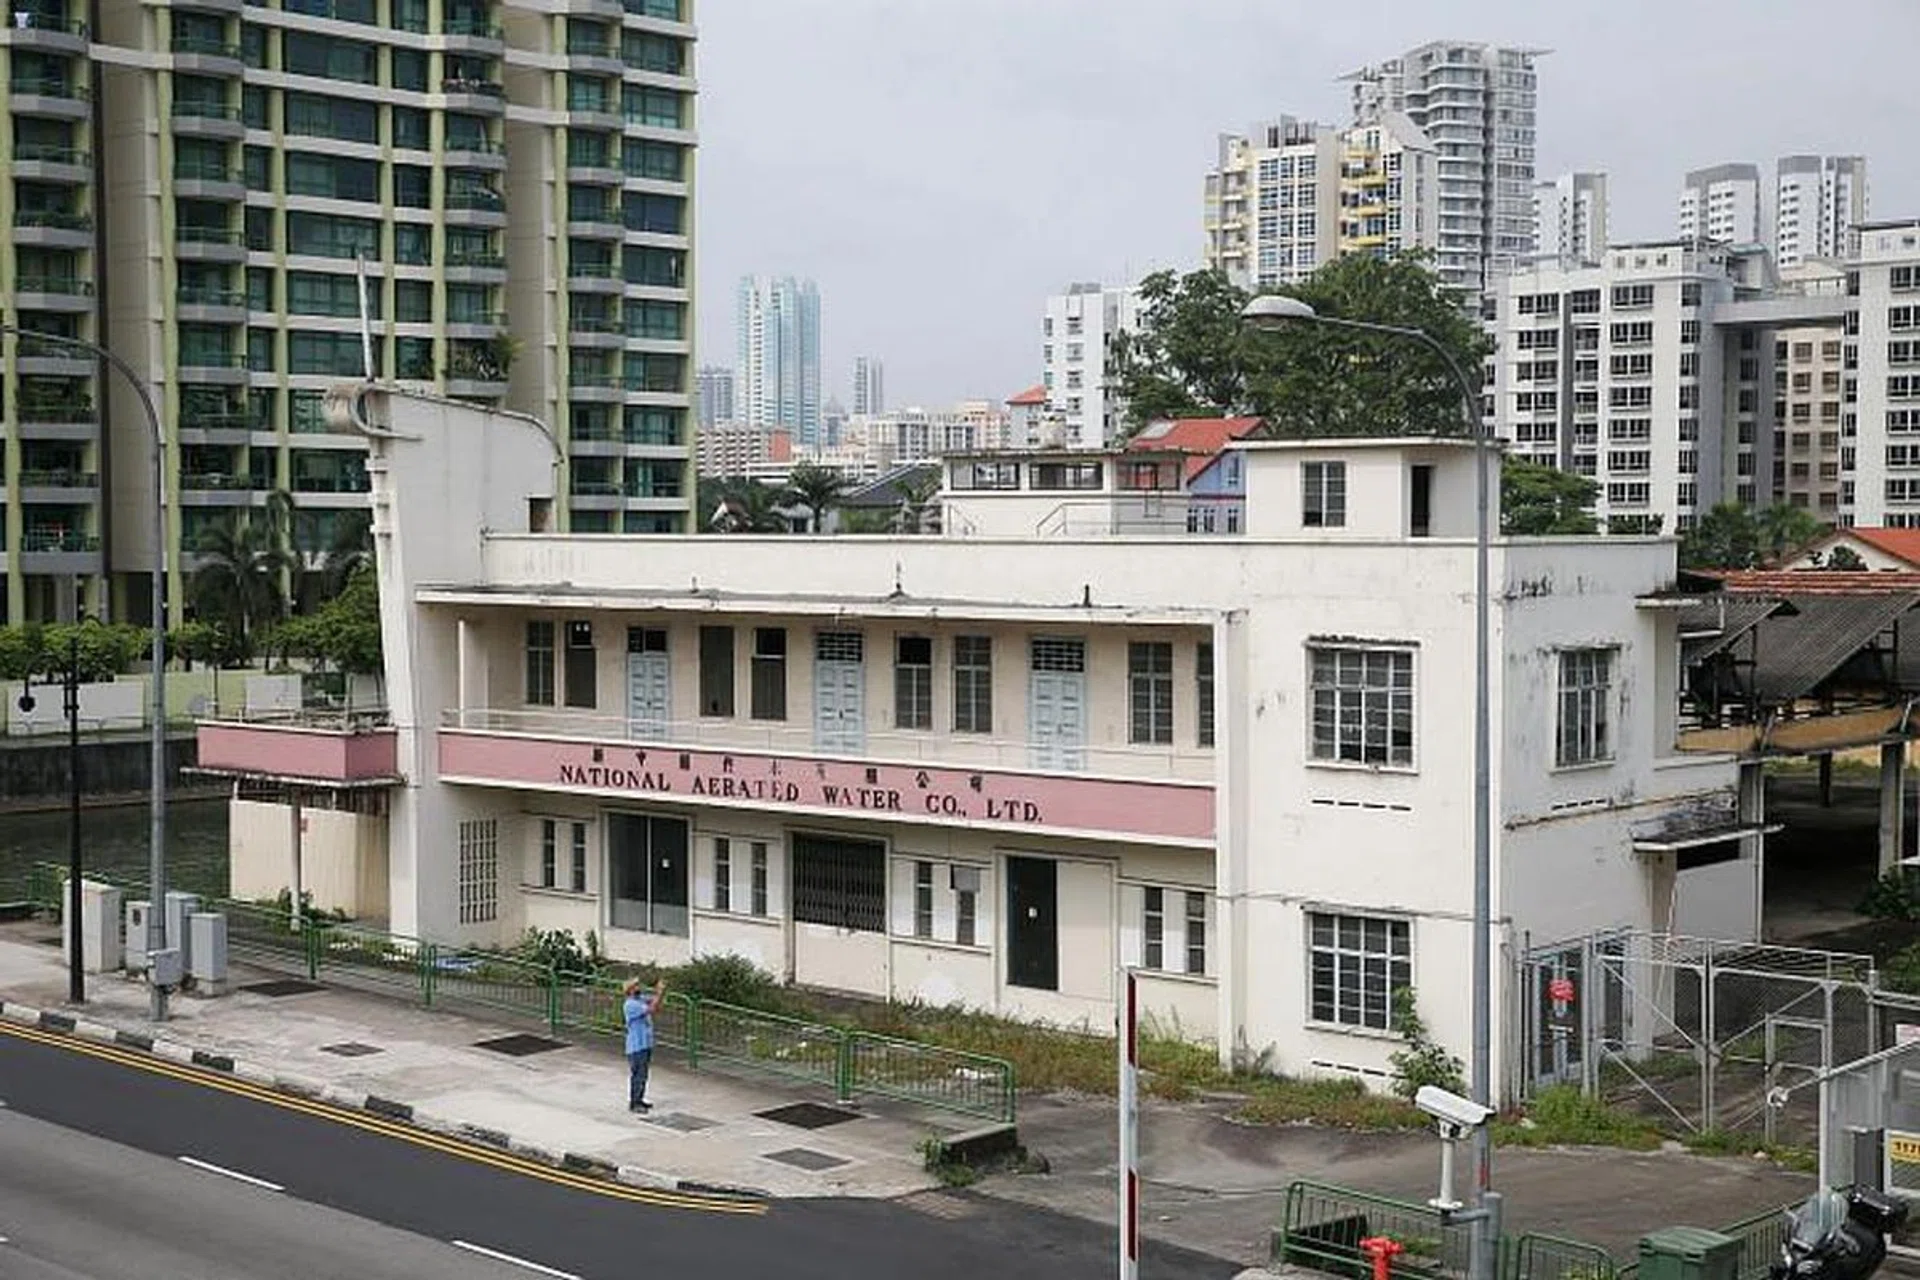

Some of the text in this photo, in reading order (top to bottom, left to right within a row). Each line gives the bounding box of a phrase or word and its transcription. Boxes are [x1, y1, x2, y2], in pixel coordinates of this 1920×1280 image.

[560, 764, 671, 792] NATIONAL
[691, 775, 799, 802] AERATED
[822, 785, 901, 811] WATER
[987, 799, 1043, 823] LTD.
